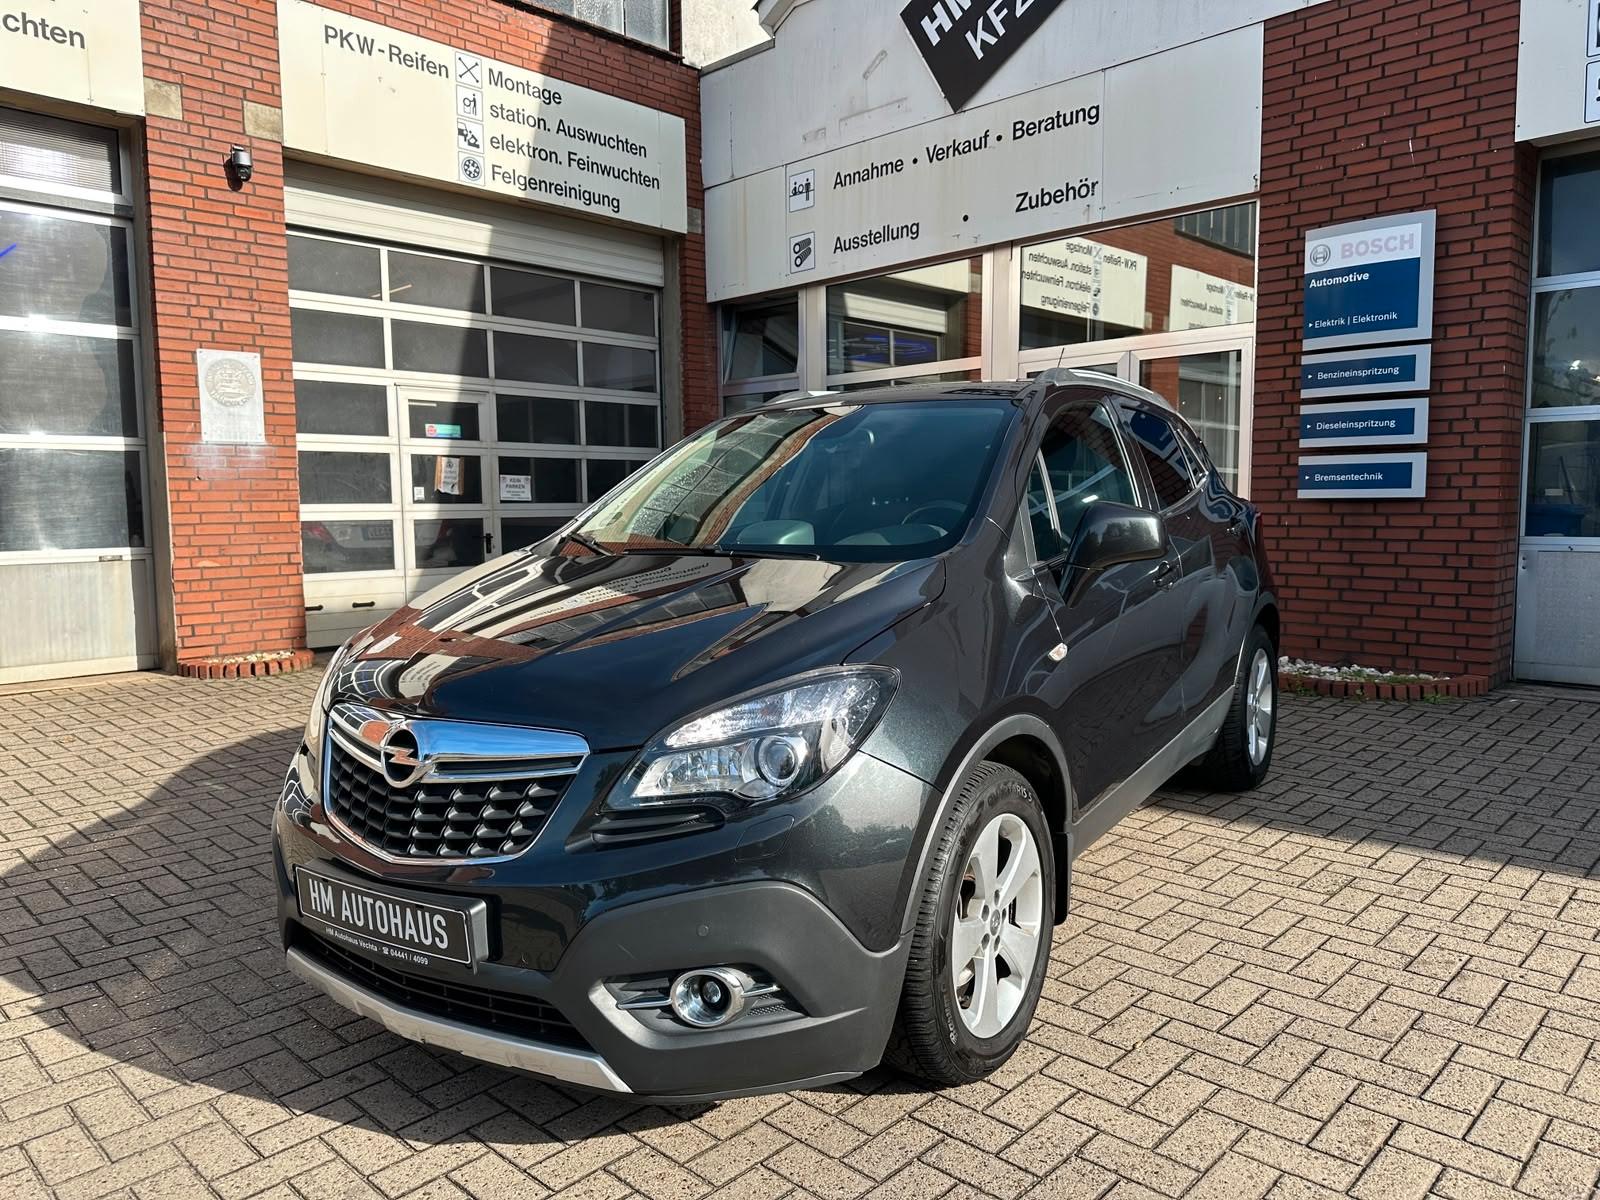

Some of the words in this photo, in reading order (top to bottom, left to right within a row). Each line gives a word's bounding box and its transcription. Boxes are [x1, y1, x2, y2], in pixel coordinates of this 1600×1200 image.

[2, 11, 85, 49] chten
[324, 25, 449, 79] PKW-Reifen
[488, 67, 562, 105] Montage
[489, 103, 551, 132] station.
[556, 119, 647, 158] Auswuchten
[833, 158, 904, 190] Annahme
[926, 129, 990, 164] Verkauf
[1012, 104, 1101, 141] Beratung
[489, 134, 562, 165] elektron.
[567, 151, 660, 190] Feinwuchten
[491, 164, 620, 213] Felgenreinigung
[1015, 178, 1099, 213] Zubehör
[833, 219, 920, 255] Ausstellung
[1340, 233, 1414, 259] BOSCH
[1309, 272, 1370, 289] Automotive
[1314, 317, 1345, 328] Elektrik
[1352, 311, 1398, 324] Elektronik
[1317, 366, 1400, 380] Benzineinspritzung
[1316, 419, 1396, 430] Dieseleinspritzung
[1314, 472, 1384, 482] Bremsentechnik
[308, 878, 336, 918] HM
[341, 889, 449, 949] AUTOHAUS
[325, 926, 334, 936] HM
[334, 930, 359, 945] Autohaus
[359, 939, 378, 952] Vechta
[390, 949, 408, 960] 04441
[413, 954, 429, 965] 4099
